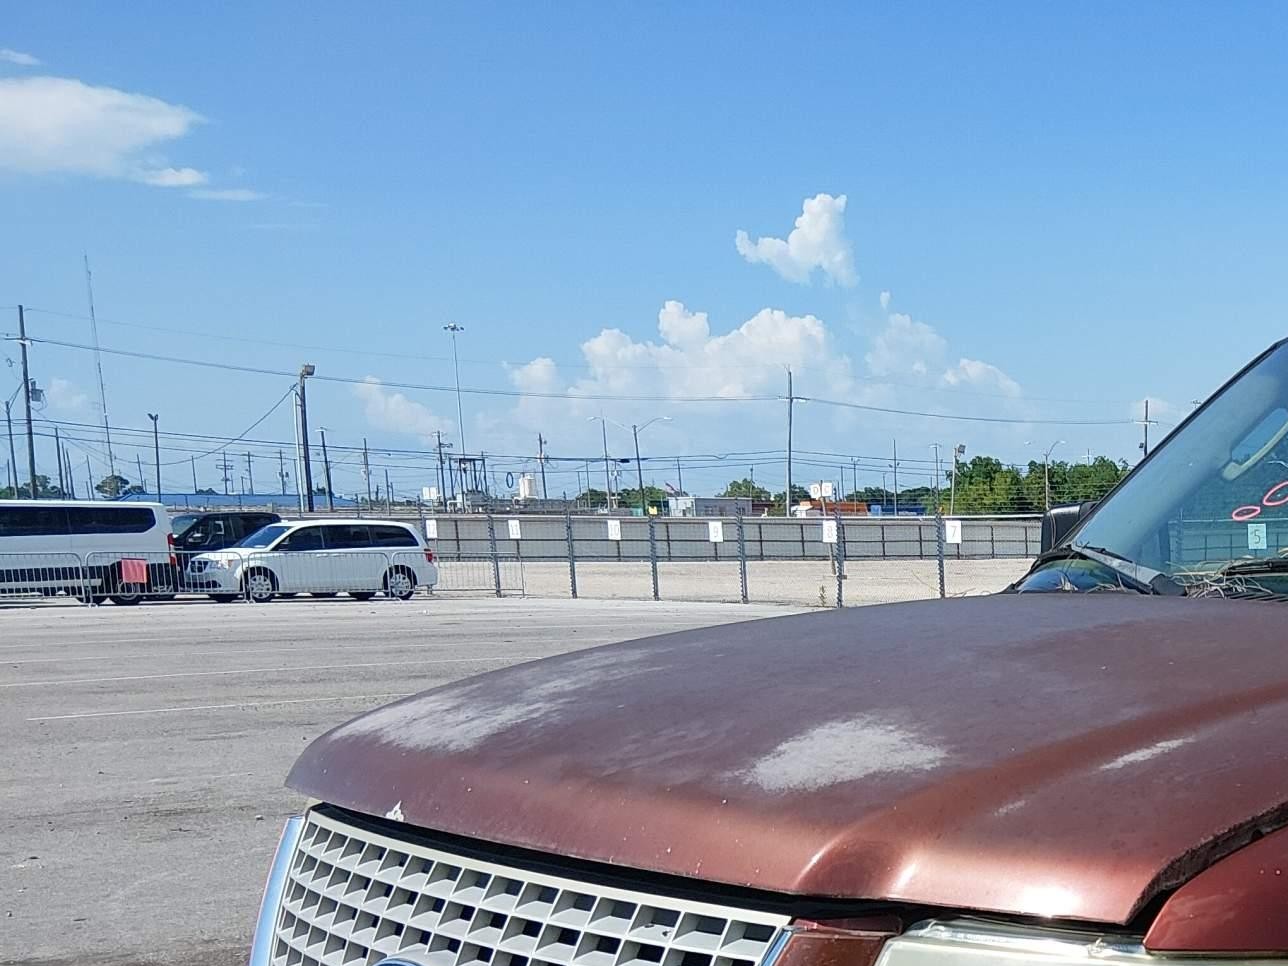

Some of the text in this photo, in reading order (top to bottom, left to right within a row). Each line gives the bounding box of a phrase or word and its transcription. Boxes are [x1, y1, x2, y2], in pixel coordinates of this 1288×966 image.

[609, 523, 620, 537] 10
[950, 525, 958, 538] 7
[1253, 528, 1262, 545] 5
